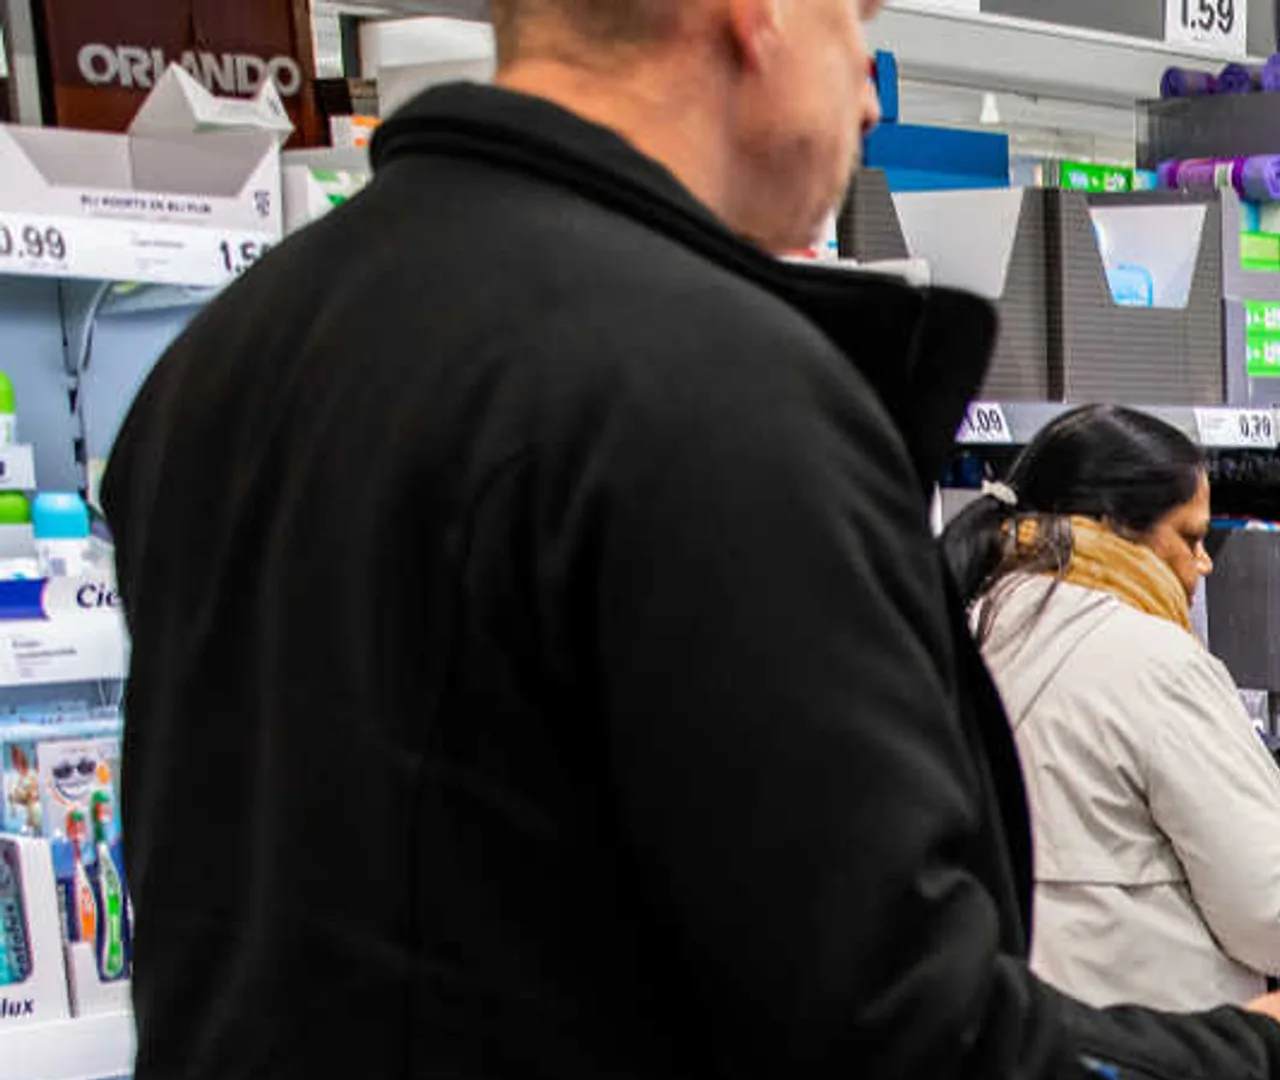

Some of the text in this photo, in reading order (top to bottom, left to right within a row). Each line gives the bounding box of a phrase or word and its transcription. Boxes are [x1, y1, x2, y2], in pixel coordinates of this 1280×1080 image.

[1179, 0, 1235, 34] 1.59
[219, 240, 271, 274] 1.5
[0, 998, 35, 1018] lux
